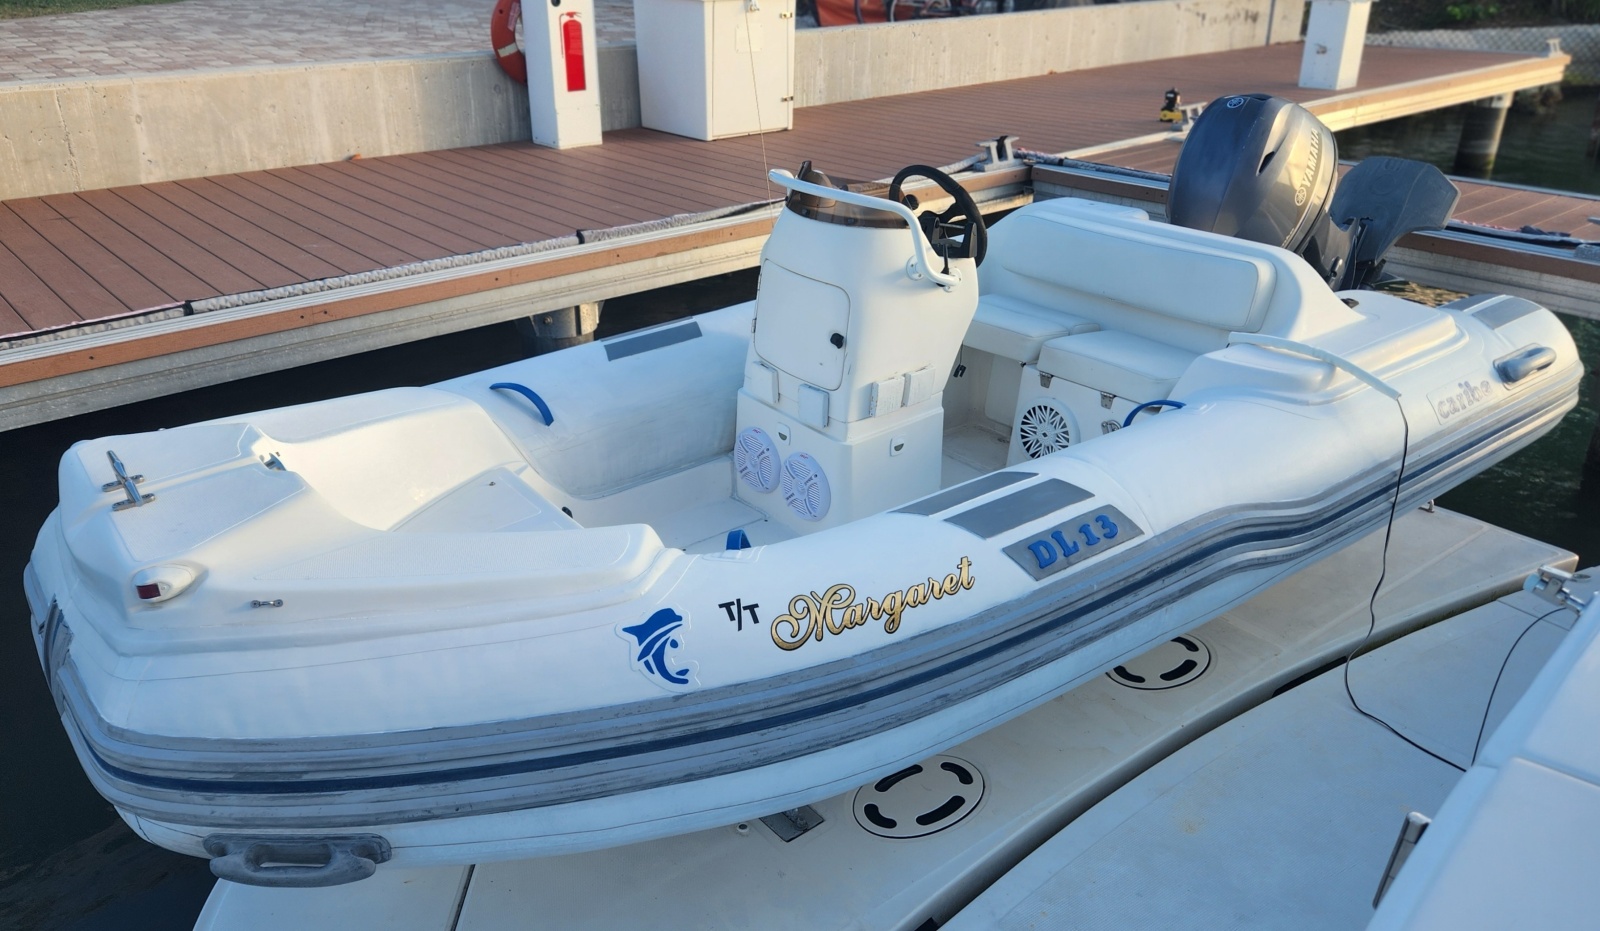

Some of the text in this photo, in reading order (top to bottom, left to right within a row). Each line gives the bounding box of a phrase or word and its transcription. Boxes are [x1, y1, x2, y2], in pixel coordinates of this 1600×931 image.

[1301, 127, 1319, 188] YAMAHA
[1437, 380, 1492, 419] caribe
[718, 555, 975, 651] T/T Margaret
